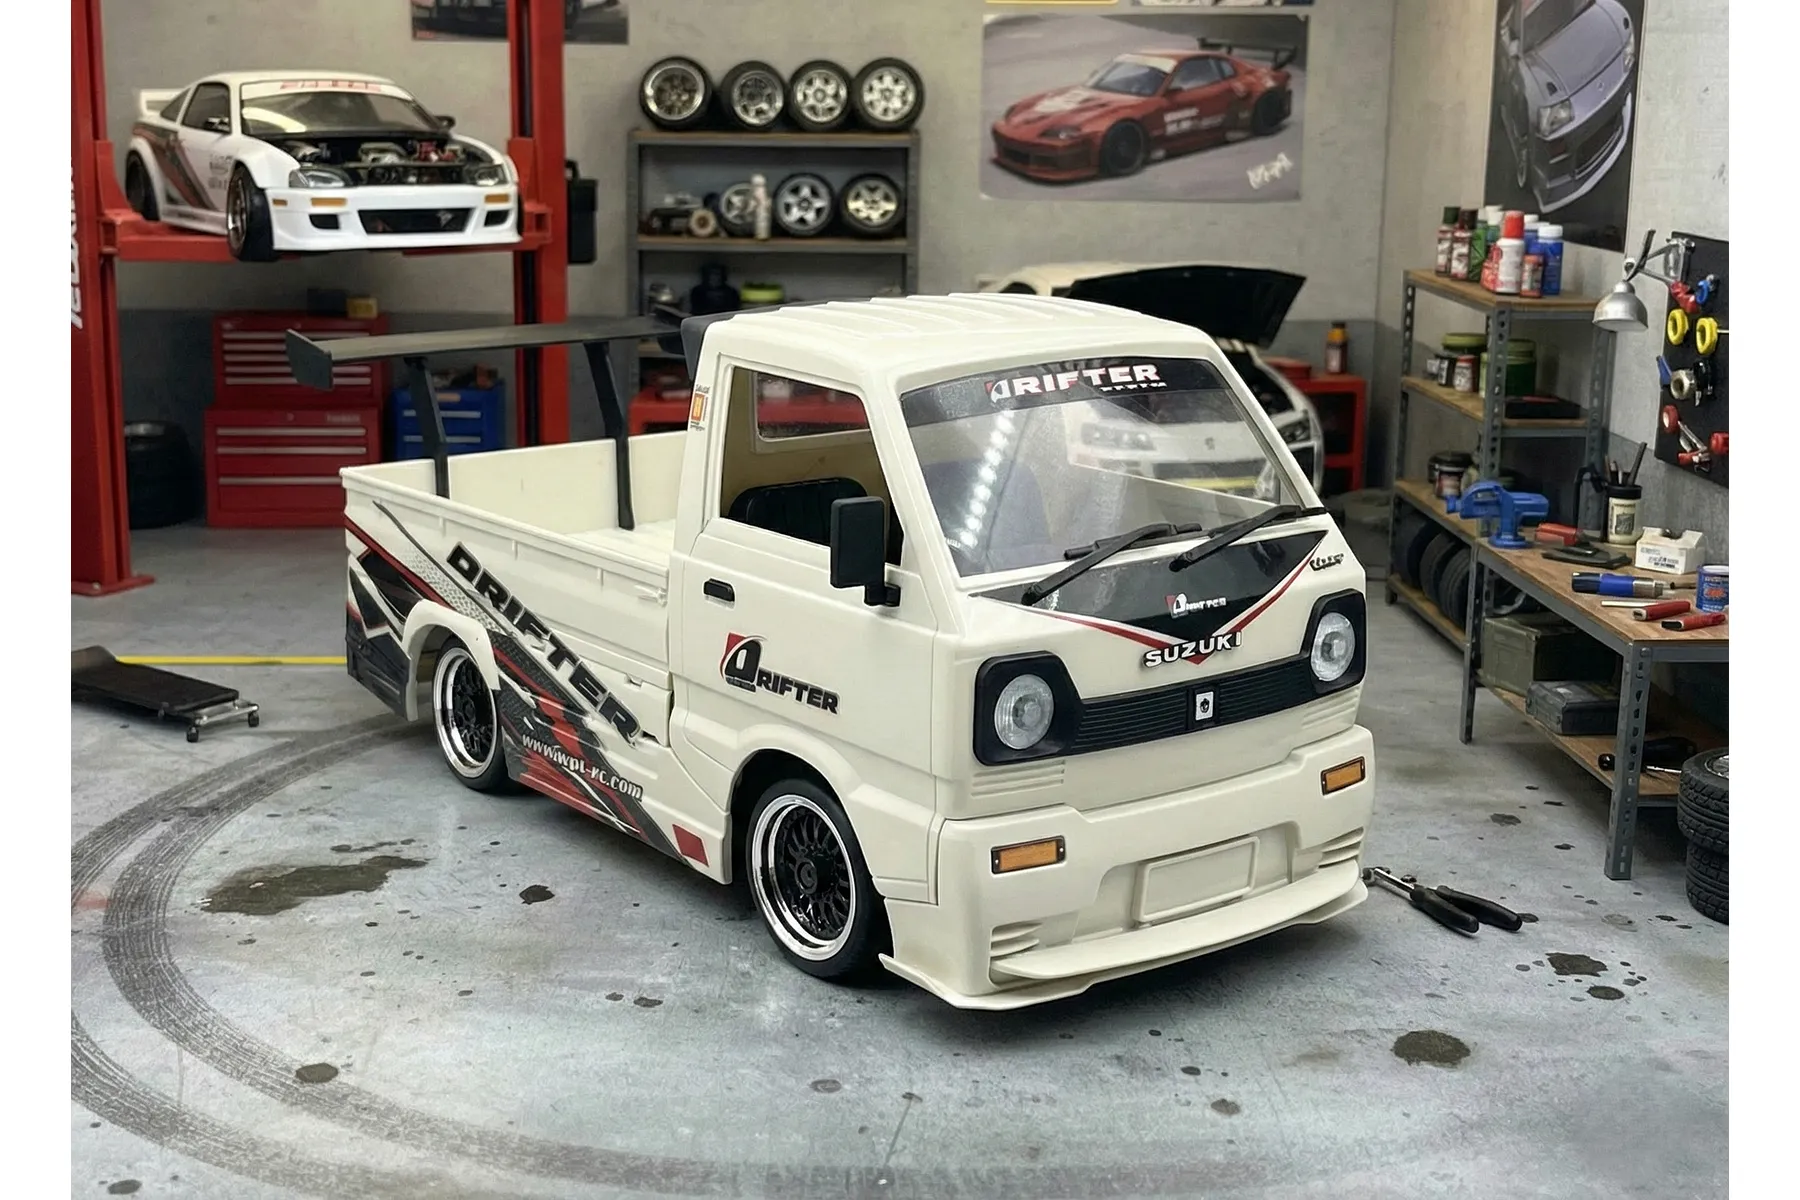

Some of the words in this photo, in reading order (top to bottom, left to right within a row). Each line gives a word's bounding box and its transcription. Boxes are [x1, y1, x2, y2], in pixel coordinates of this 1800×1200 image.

[990, 364, 1160, 403] DRIFTER
[447, 543, 640, 746] DRIFTER
[1145, 632, 1241, 668] SUZUKI
[724, 640, 839, 714] DRIFTER
